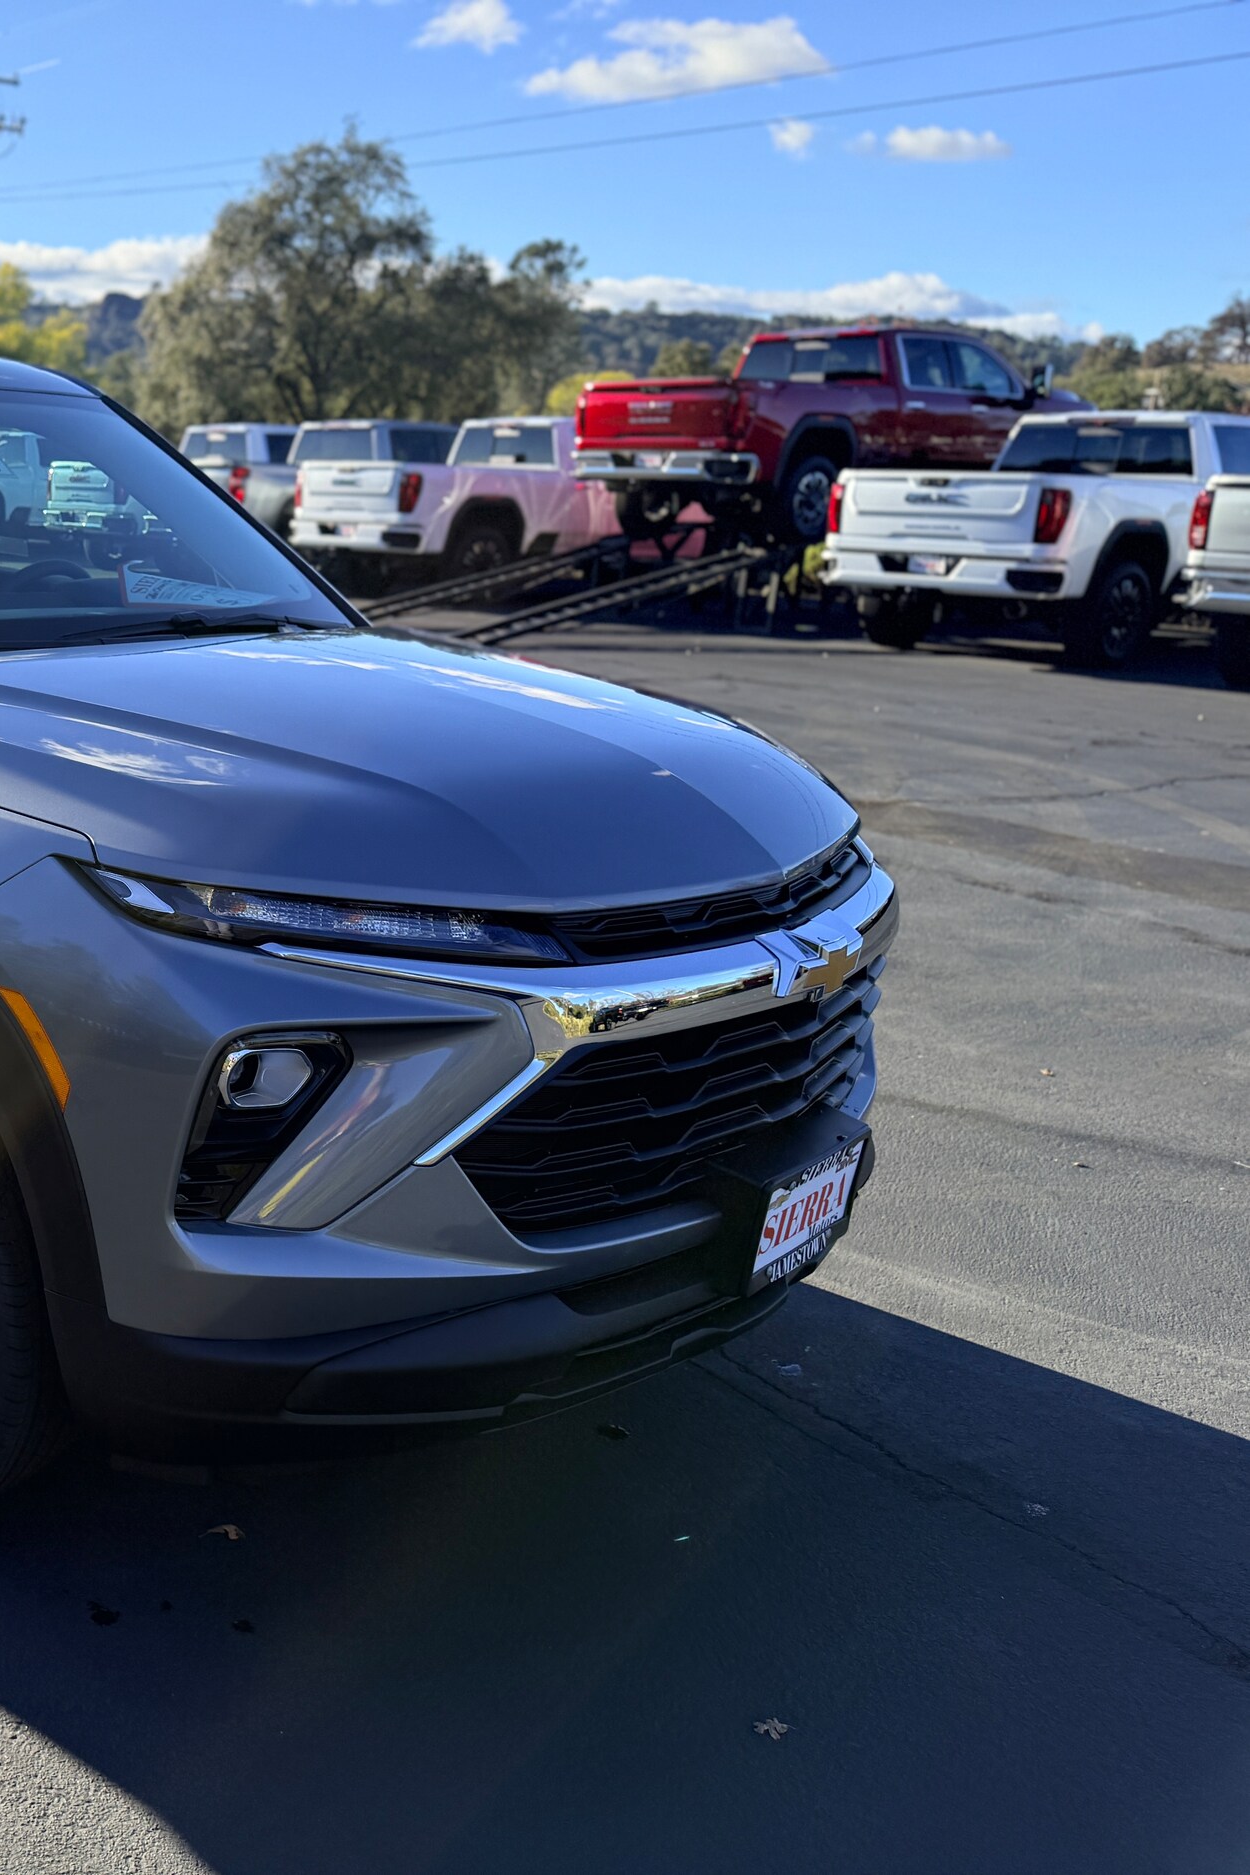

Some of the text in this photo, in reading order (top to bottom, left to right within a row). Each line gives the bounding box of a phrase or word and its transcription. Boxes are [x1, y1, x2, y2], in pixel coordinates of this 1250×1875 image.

[800, 1145, 850, 1184] SIERRA
[758, 1173, 846, 1255] SIERRA
[770, 1232, 827, 1283] JAMESTOWN
